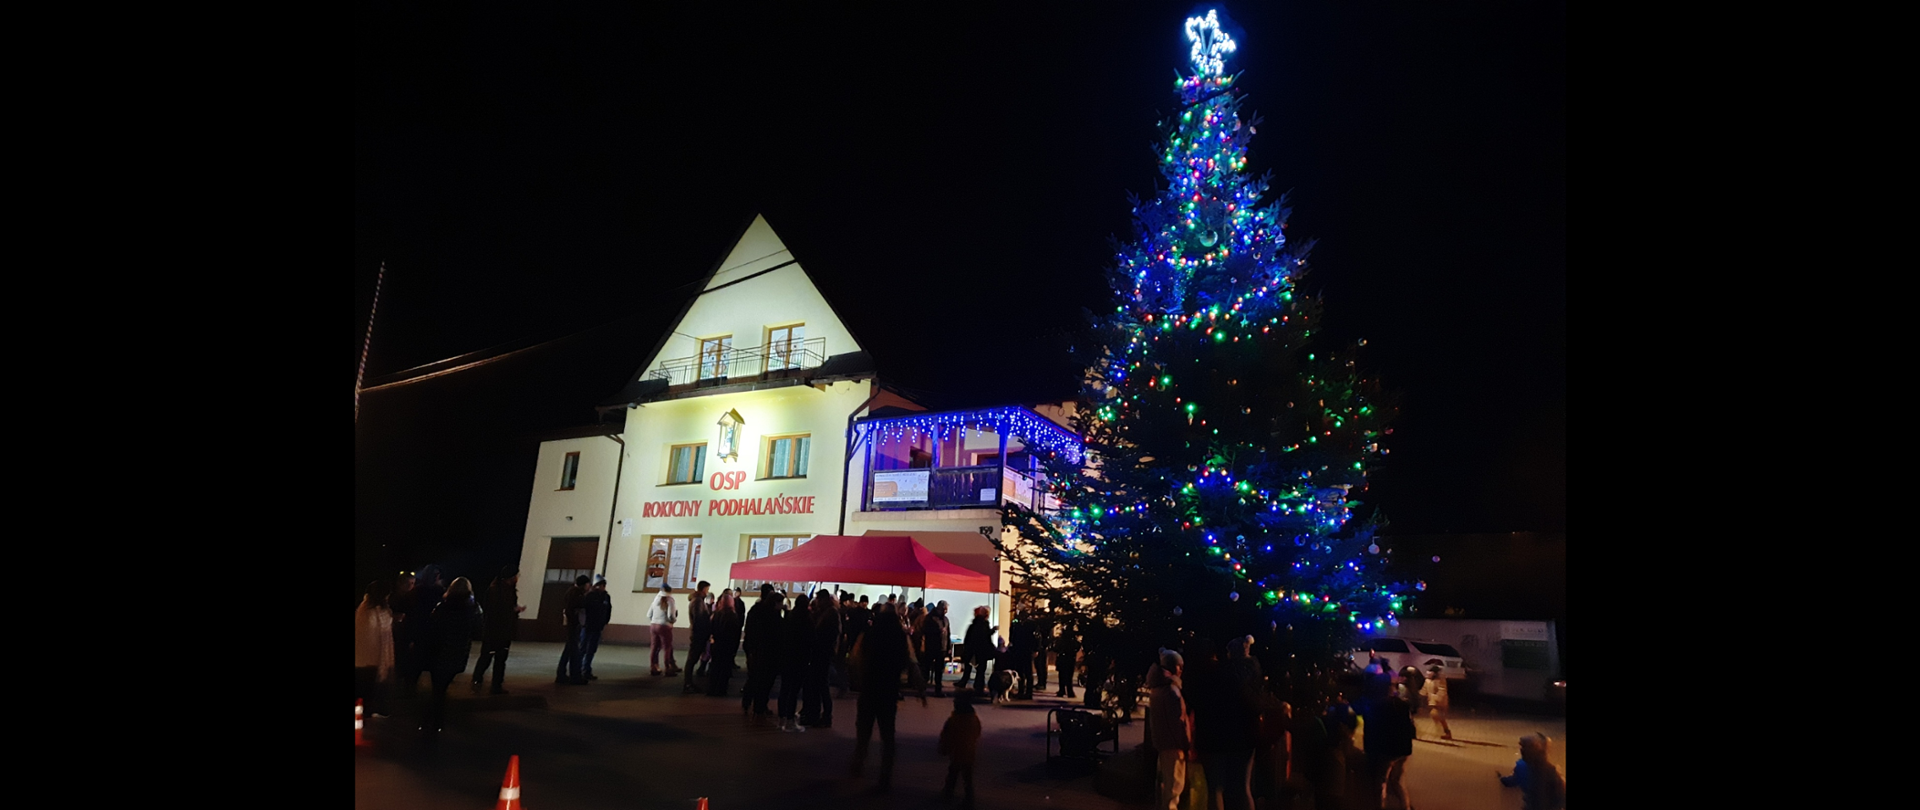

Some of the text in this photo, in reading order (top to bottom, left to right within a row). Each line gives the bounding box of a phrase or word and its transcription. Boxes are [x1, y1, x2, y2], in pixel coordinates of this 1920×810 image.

[710, 471, 746, 490] OSP
[642, 493, 815, 518] ROKICINY PODHALAŃSKIE
